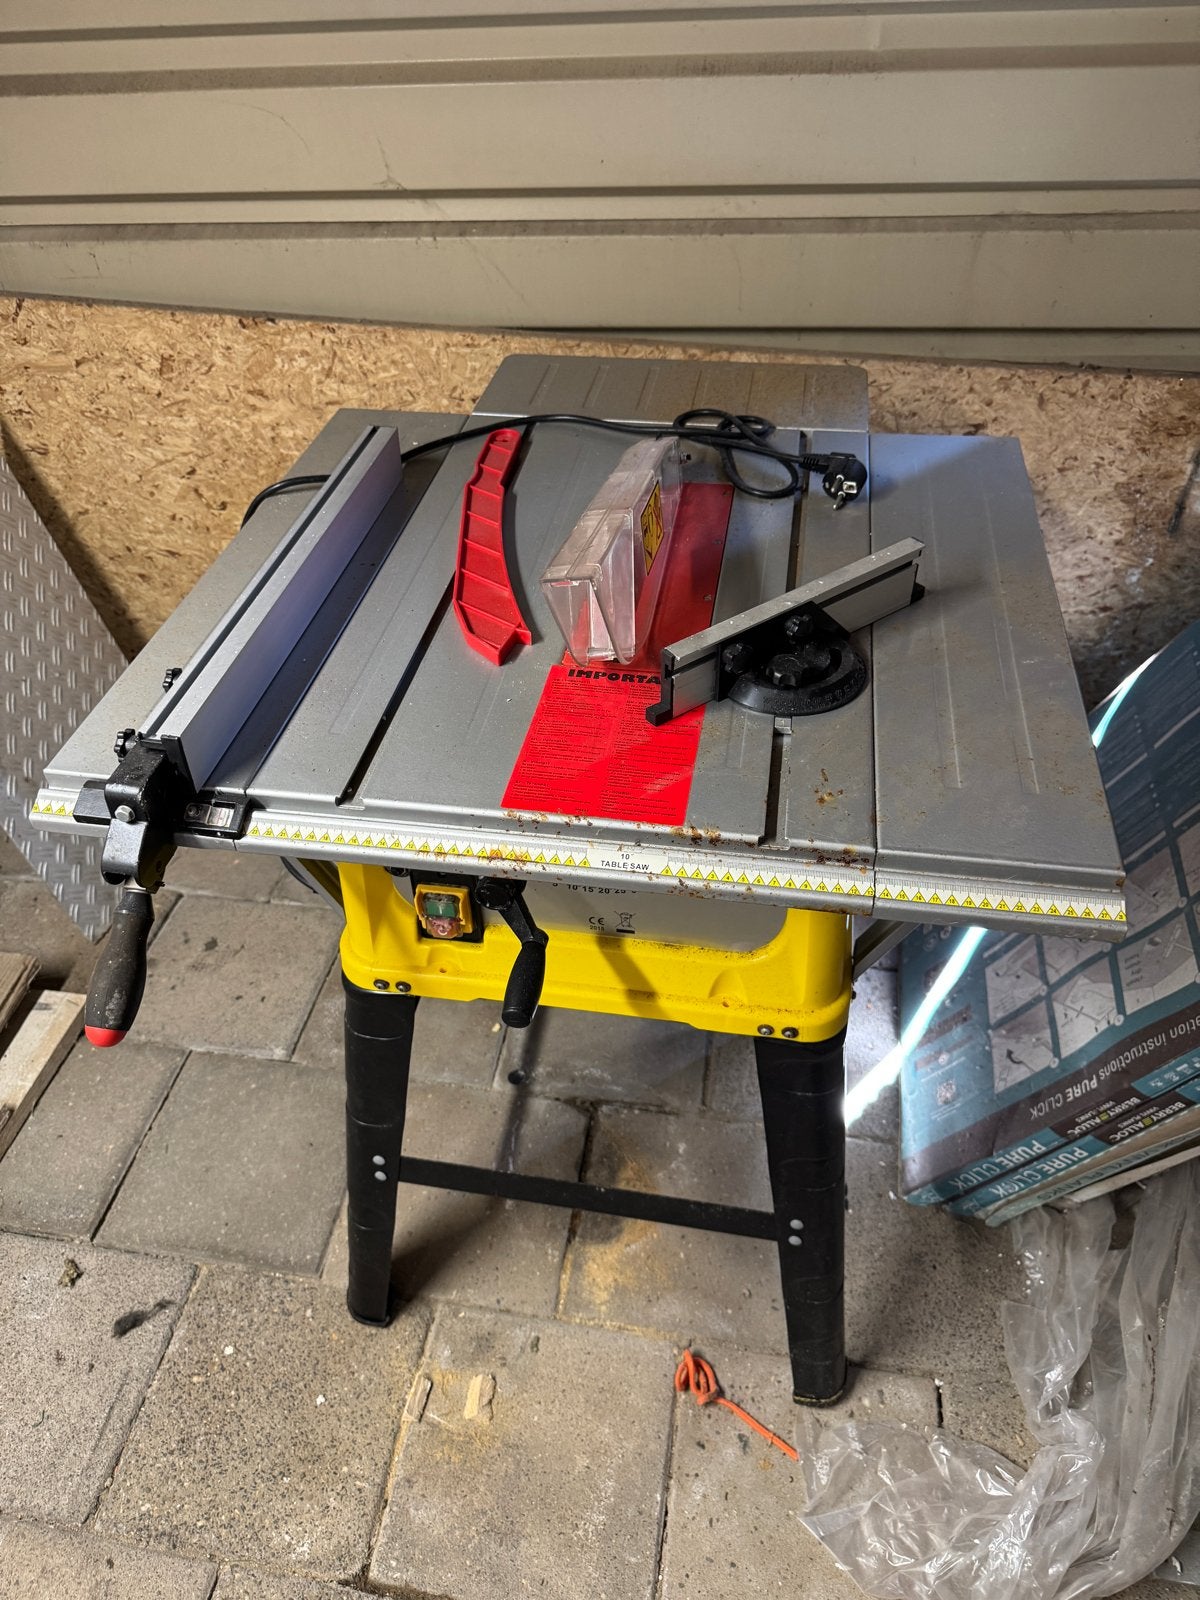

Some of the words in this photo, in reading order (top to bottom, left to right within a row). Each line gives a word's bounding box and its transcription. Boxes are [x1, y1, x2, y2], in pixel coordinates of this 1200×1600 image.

[601, 860, 628, 869] TABLE
[588, 916, 605, 925] CE
[1099, 1032, 1167, 1080] instructions
[1066, 1074, 1098, 1102] PURE
[1030, 1094, 1064, 1120] CLICK
[1108, 1097, 1141, 1118] BERRY
[1151, 1101, 1186, 1122] BERRY
[1067, 1116, 1101, 1137] ALLOC
[1109, 1120, 1145, 1142] ALLOC
[995, 1140, 1047, 1170] PURE
[1041, 1147, 1089, 1176] PURE
[951, 1163, 1000, 1190] CLICK
[988, 1168, 1042, 1199] CLICK
